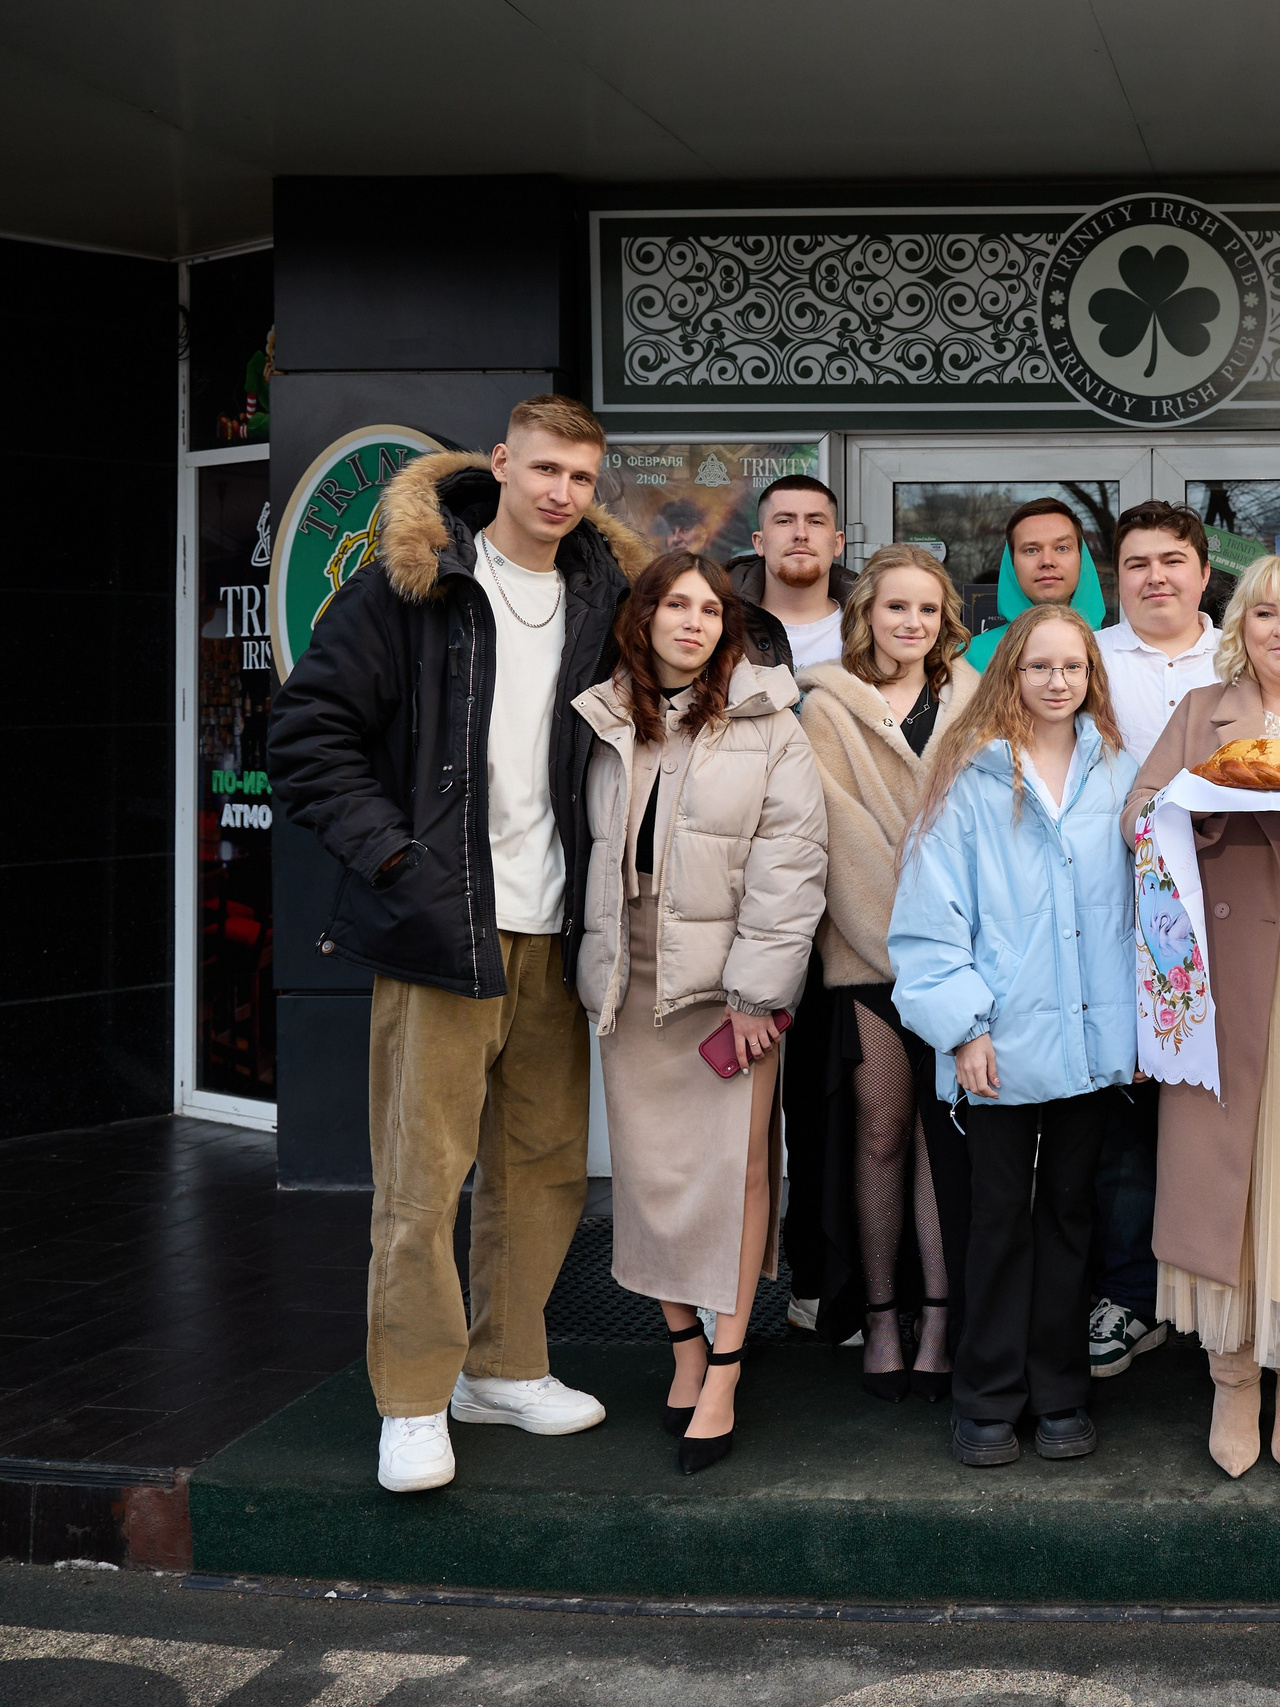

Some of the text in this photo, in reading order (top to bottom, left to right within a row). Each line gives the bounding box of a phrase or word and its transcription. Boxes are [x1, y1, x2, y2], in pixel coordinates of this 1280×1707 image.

[1050, 202, 1258, 286] TRINITY IRISH PUB
[1053, 336, 1256, 420] TRINITY IRISH PUB
[604, 454, 683, 468] 19 ФЕВРАЛЯ
[740, 458, 812, 476] TRINITY
[636, 474, 667, 485] 21:00
[212, 770, 272, 795] ПО-ИР
